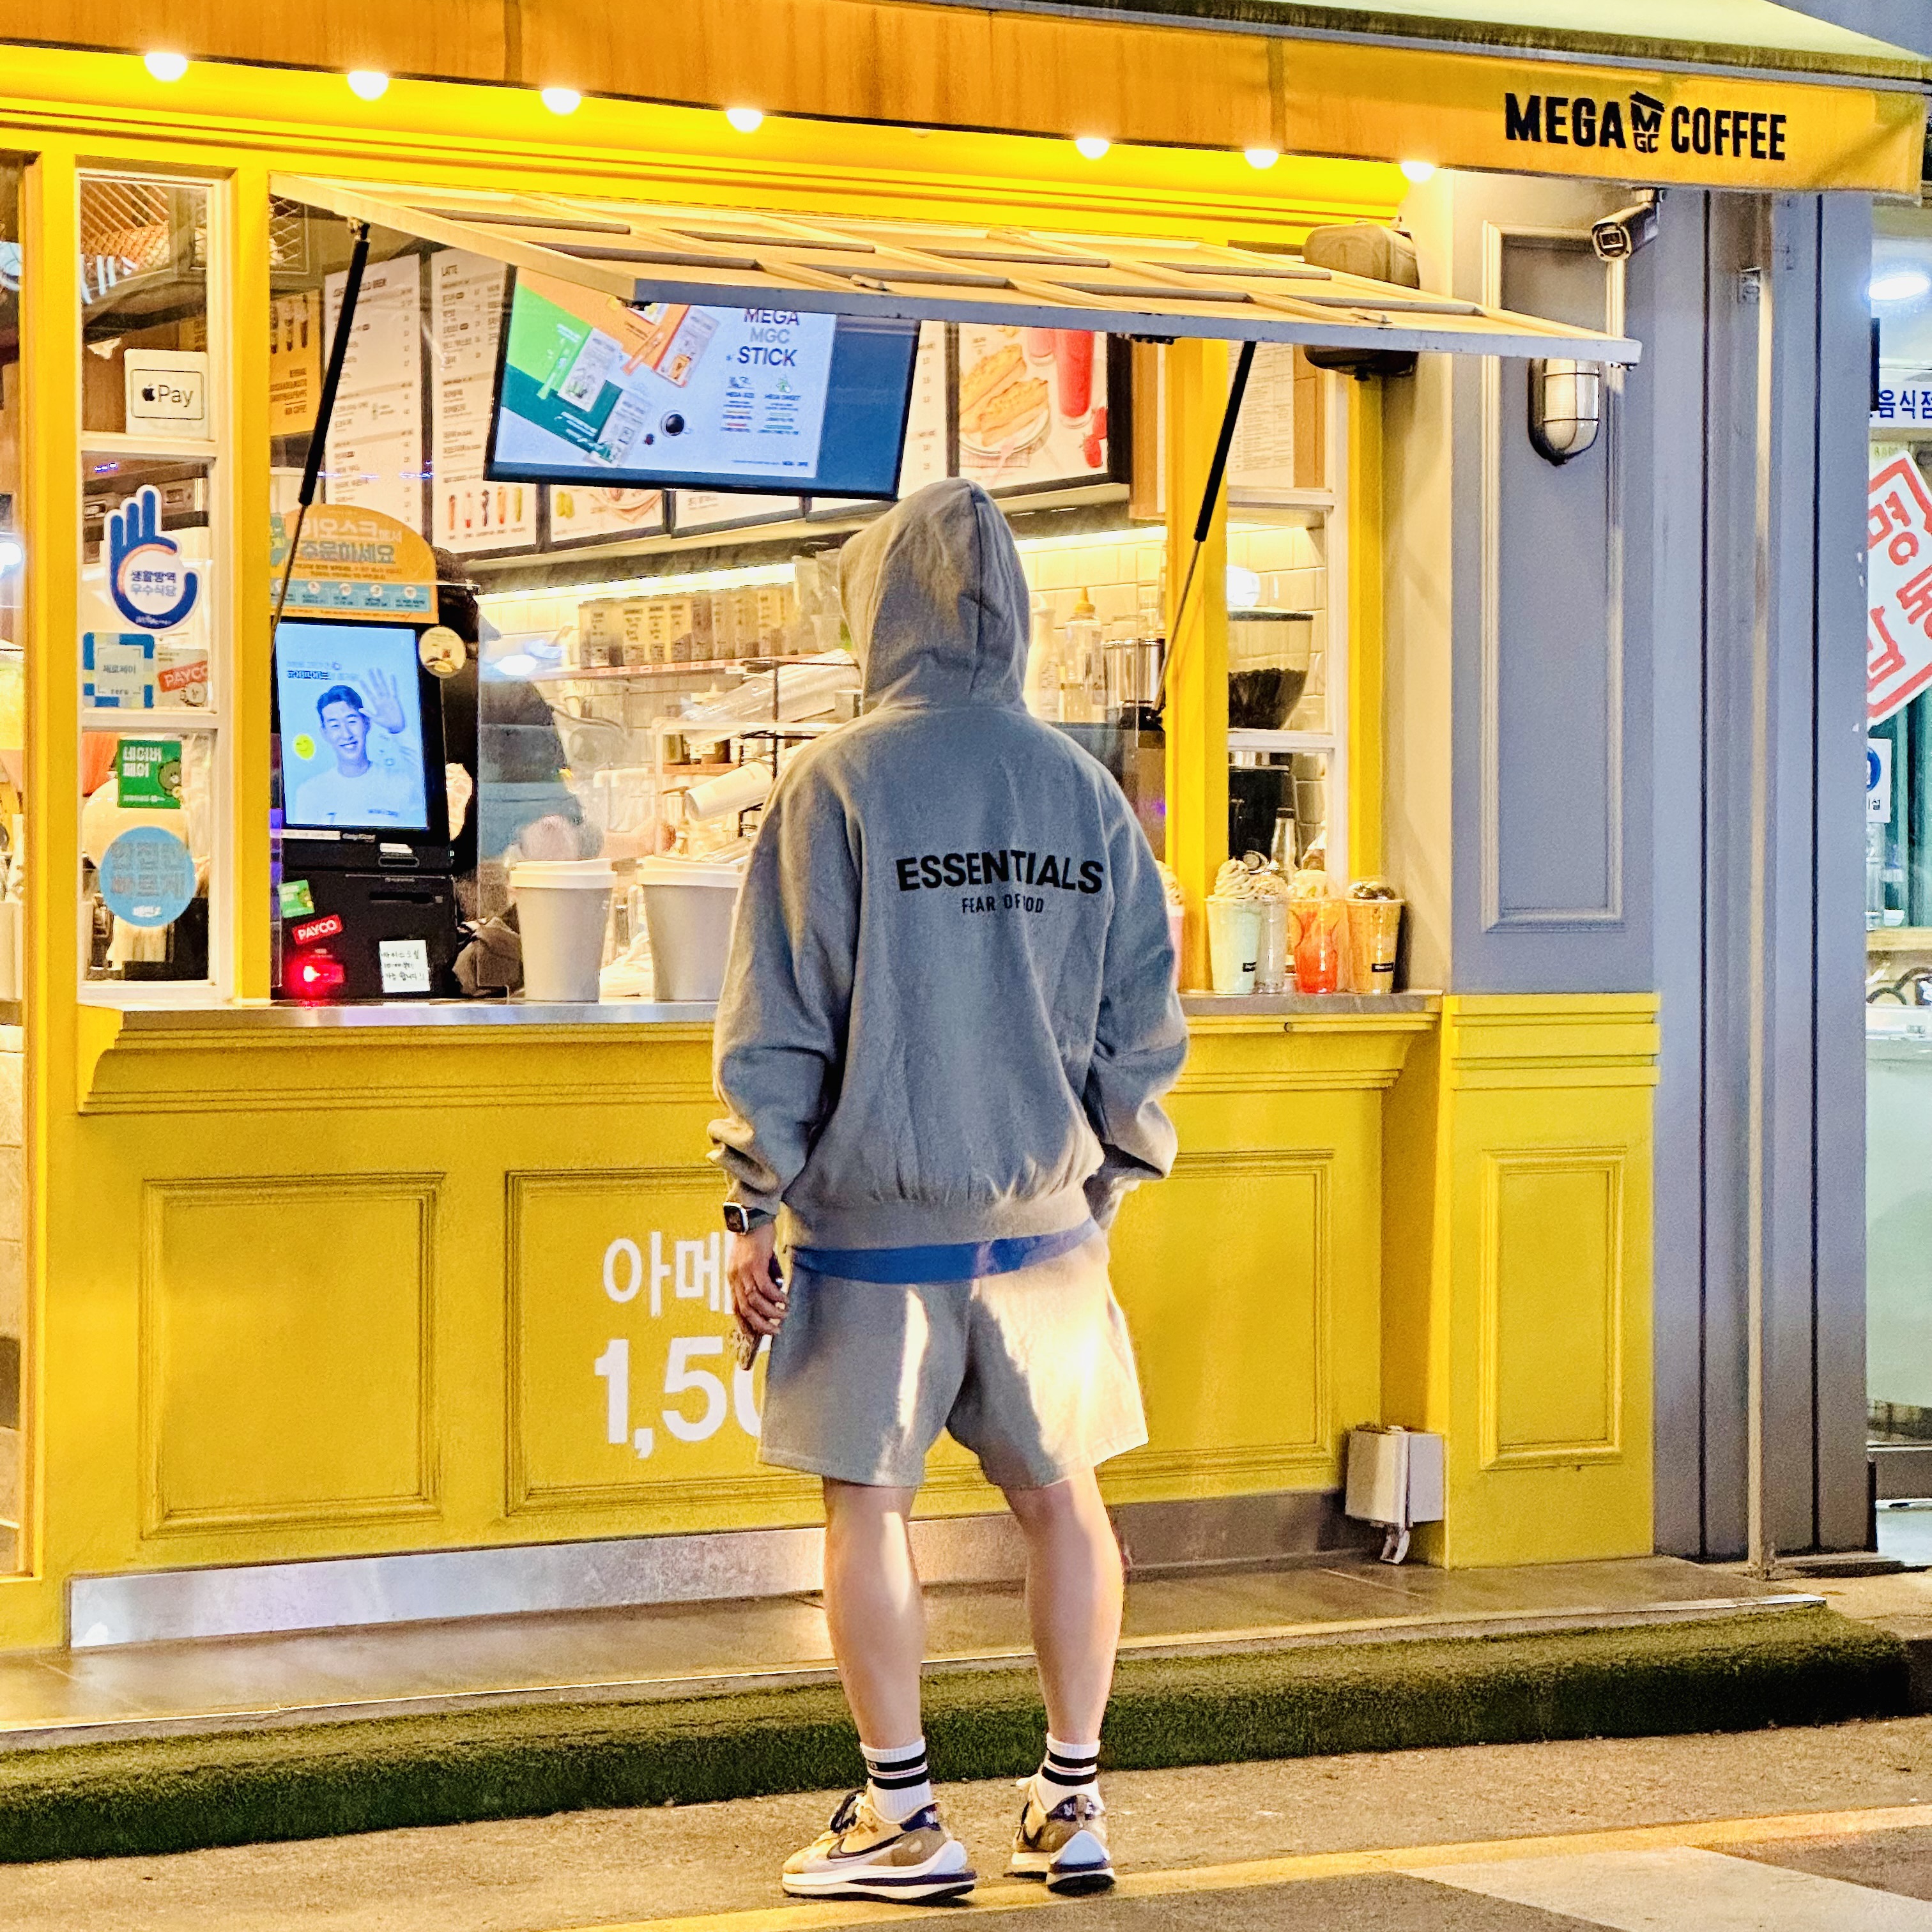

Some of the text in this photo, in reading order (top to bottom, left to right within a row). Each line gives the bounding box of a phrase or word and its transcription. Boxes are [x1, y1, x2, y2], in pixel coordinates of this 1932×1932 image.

[1505, 93, 1787, 160] MEGA COFFEE
[744, 309, 800, 326] MEGA
[751, 327, 790, 344] MGC
[737, 346, 797, 367] STICK
[158, 385, 194, 408] Pay
[1870, 389, 1932, 419] 음식점
[896, 850, 1105, 894] ESSENTIALS
[962, 894, 1045, 914] FEAR OF OD
[297, 919, 337, 941] PAYCO
